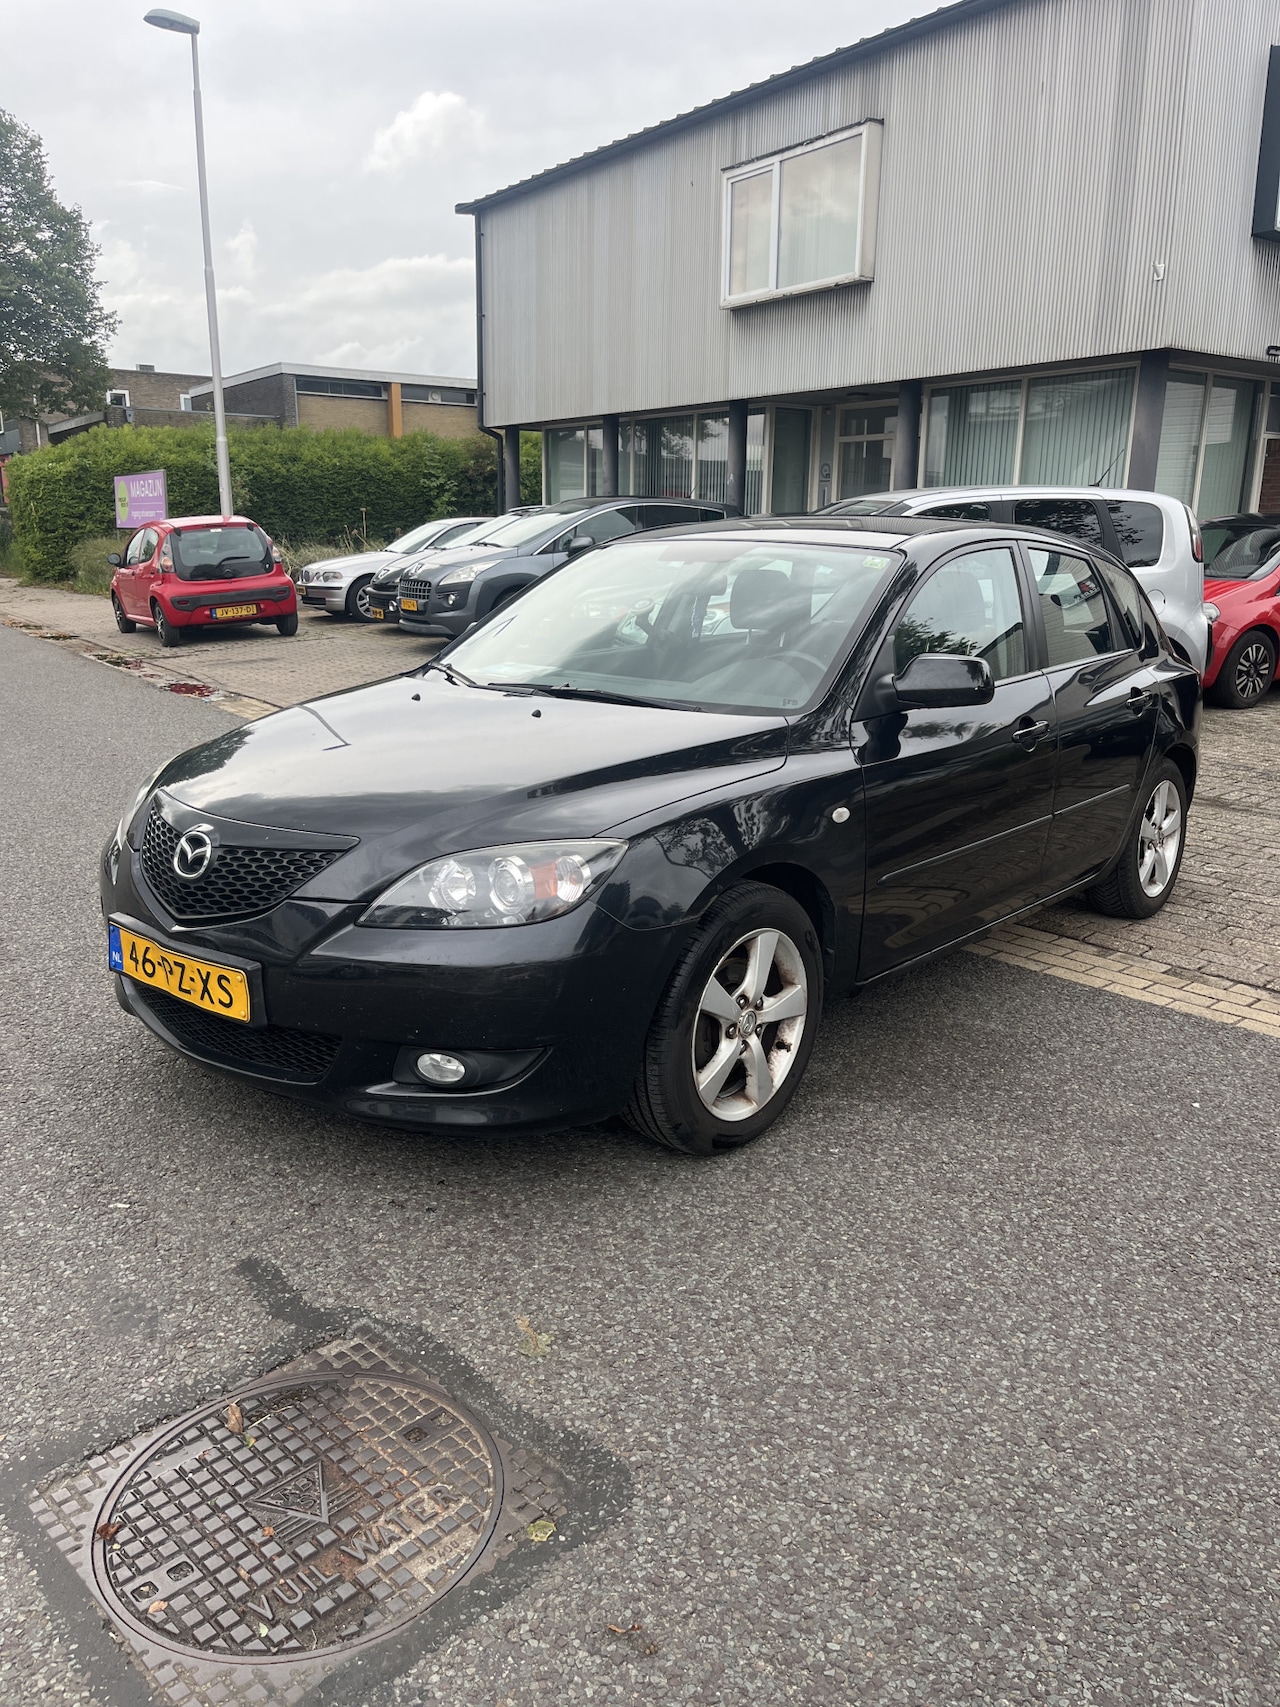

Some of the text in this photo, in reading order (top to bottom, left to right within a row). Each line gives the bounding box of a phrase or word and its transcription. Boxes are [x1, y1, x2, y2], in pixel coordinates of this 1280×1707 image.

[130, 479, 163, 498] MAGAZIJN
[112, 951, 122, 963] NL
[129, 941, 233, 1009] 46-PZ-XS
[247, 1485, 463, 1621] VUIL WATER
